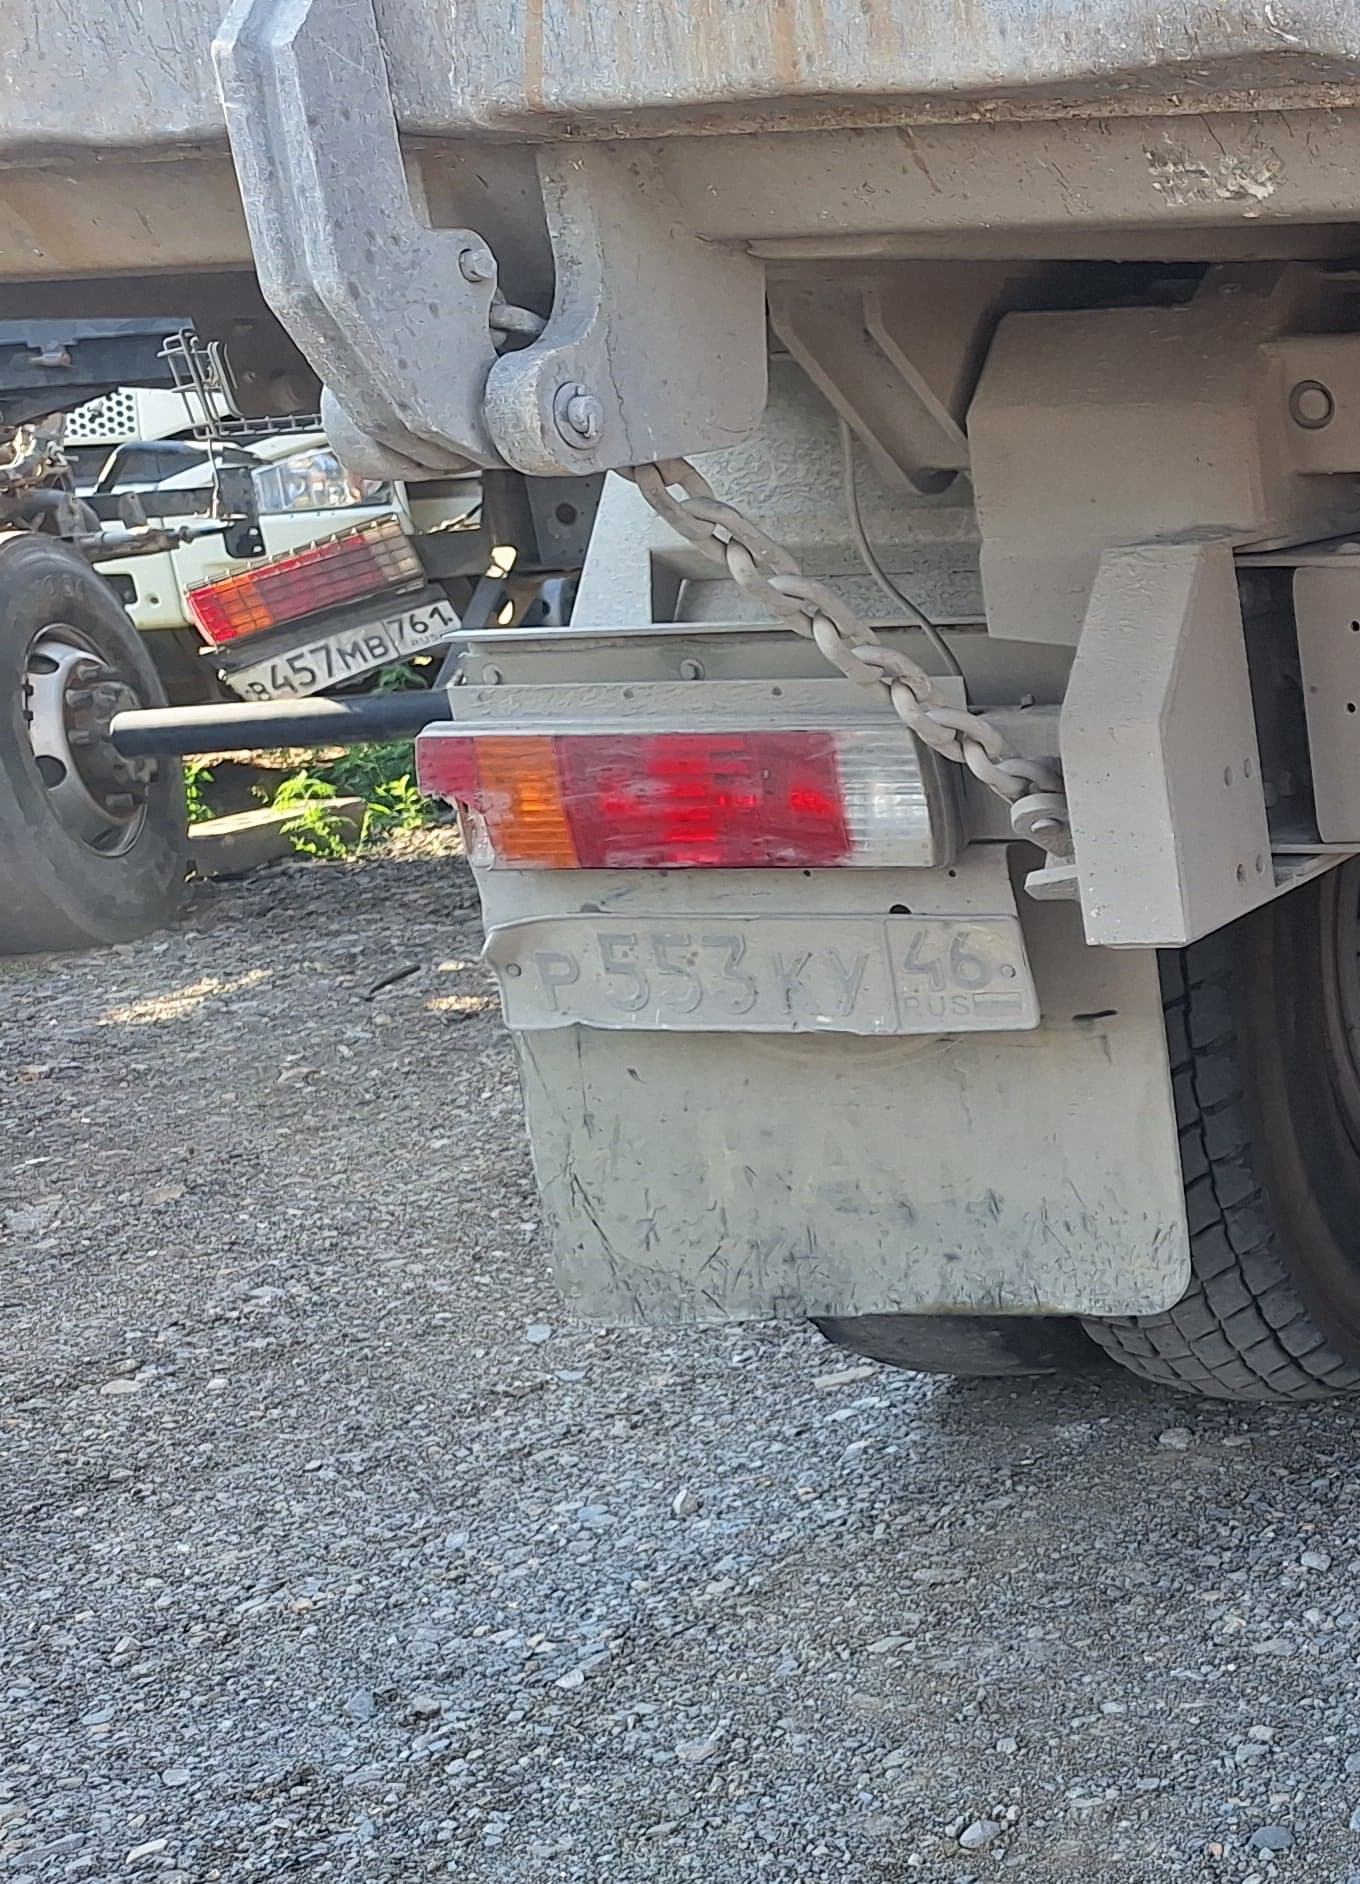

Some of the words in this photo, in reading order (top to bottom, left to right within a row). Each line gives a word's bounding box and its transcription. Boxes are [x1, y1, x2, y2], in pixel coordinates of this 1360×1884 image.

[387, 606, 449, 641] 761
[903, 930, 991, 992] 46
[903, 995, 970, 1016] RUS
